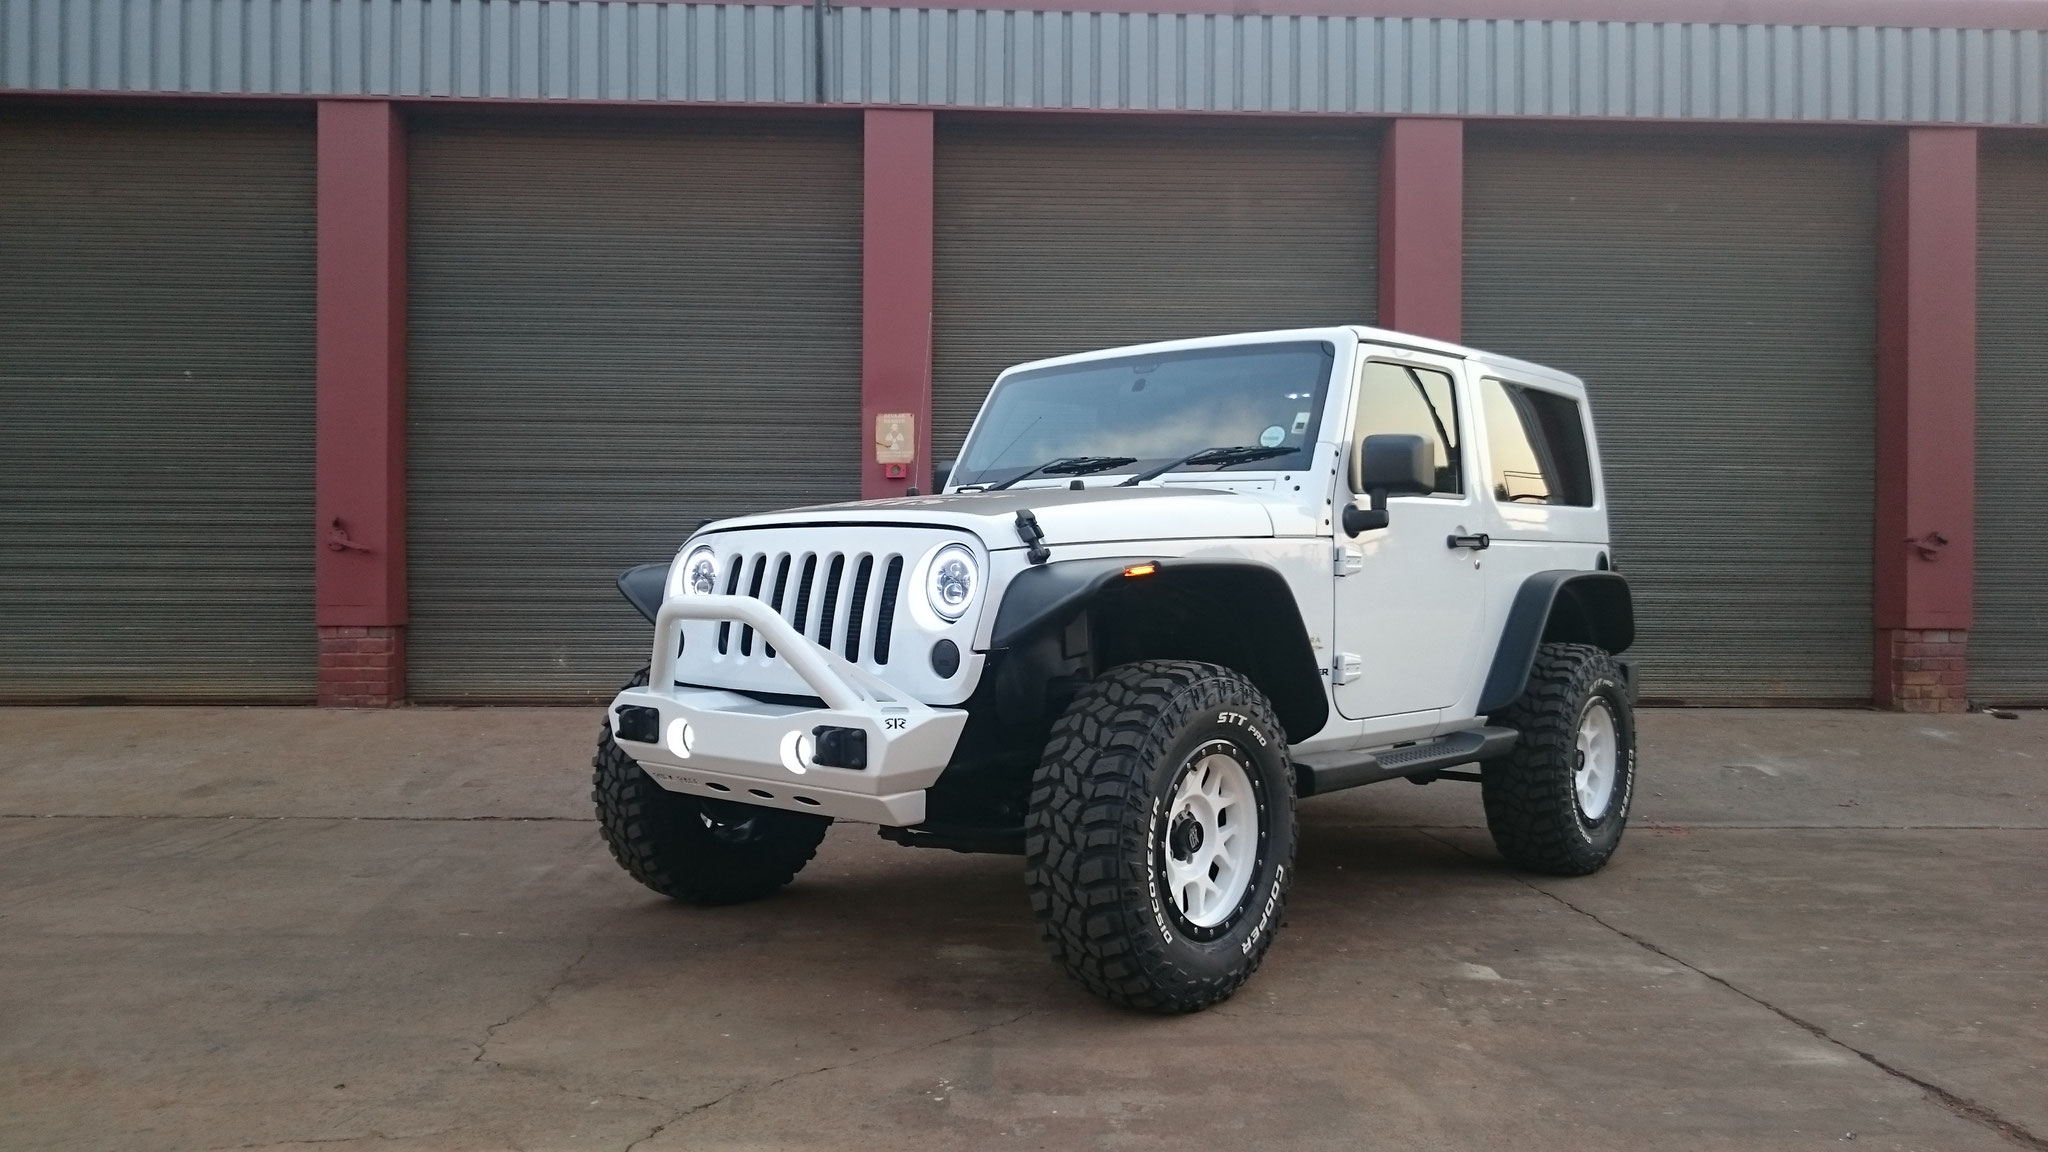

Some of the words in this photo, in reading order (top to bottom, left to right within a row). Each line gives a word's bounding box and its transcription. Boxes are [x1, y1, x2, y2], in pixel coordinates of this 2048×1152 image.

[1217, 711, 1248, 726] STT
[1247, 724, 1267, 747] PRO
[1620, 749, 1634, 818] COOPER
[1147, 796, 1174, 944] DISCOVERER
[1241, 864, 1284, 954] COOPER
